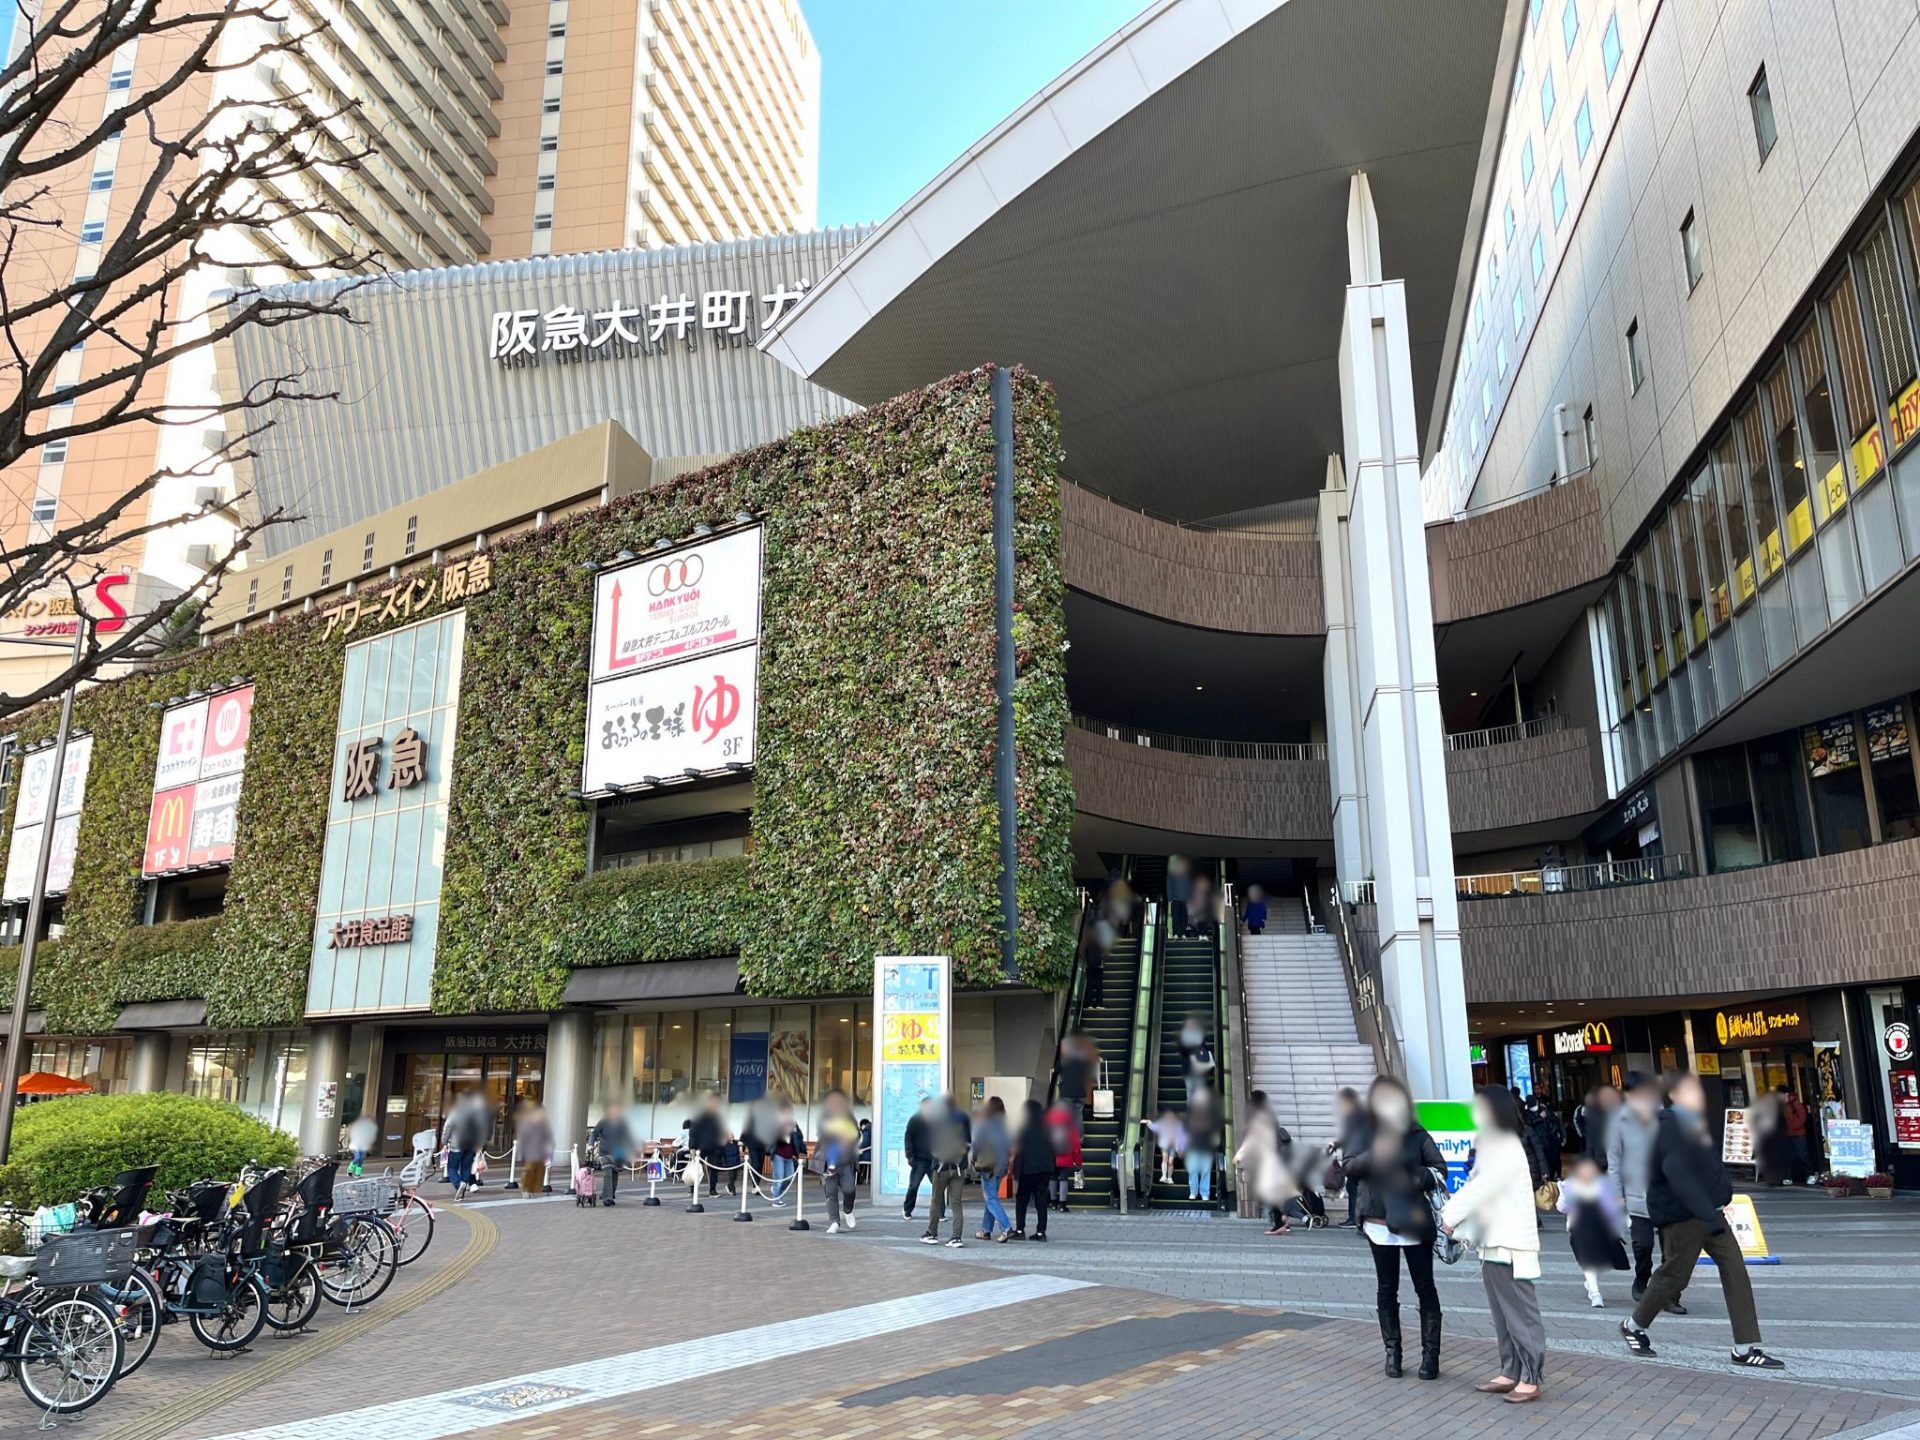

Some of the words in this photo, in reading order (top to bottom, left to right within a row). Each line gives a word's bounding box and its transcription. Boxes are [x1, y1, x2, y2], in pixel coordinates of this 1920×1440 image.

[490, 278, 811, 359] 阪急大井町ガ
[692, 675, 740, 744] ゆ
[343, 727, 427, 802] 阪急
[722, 736, 743, 757] 3F
[328, 914, 415, 949] 大井食品館
